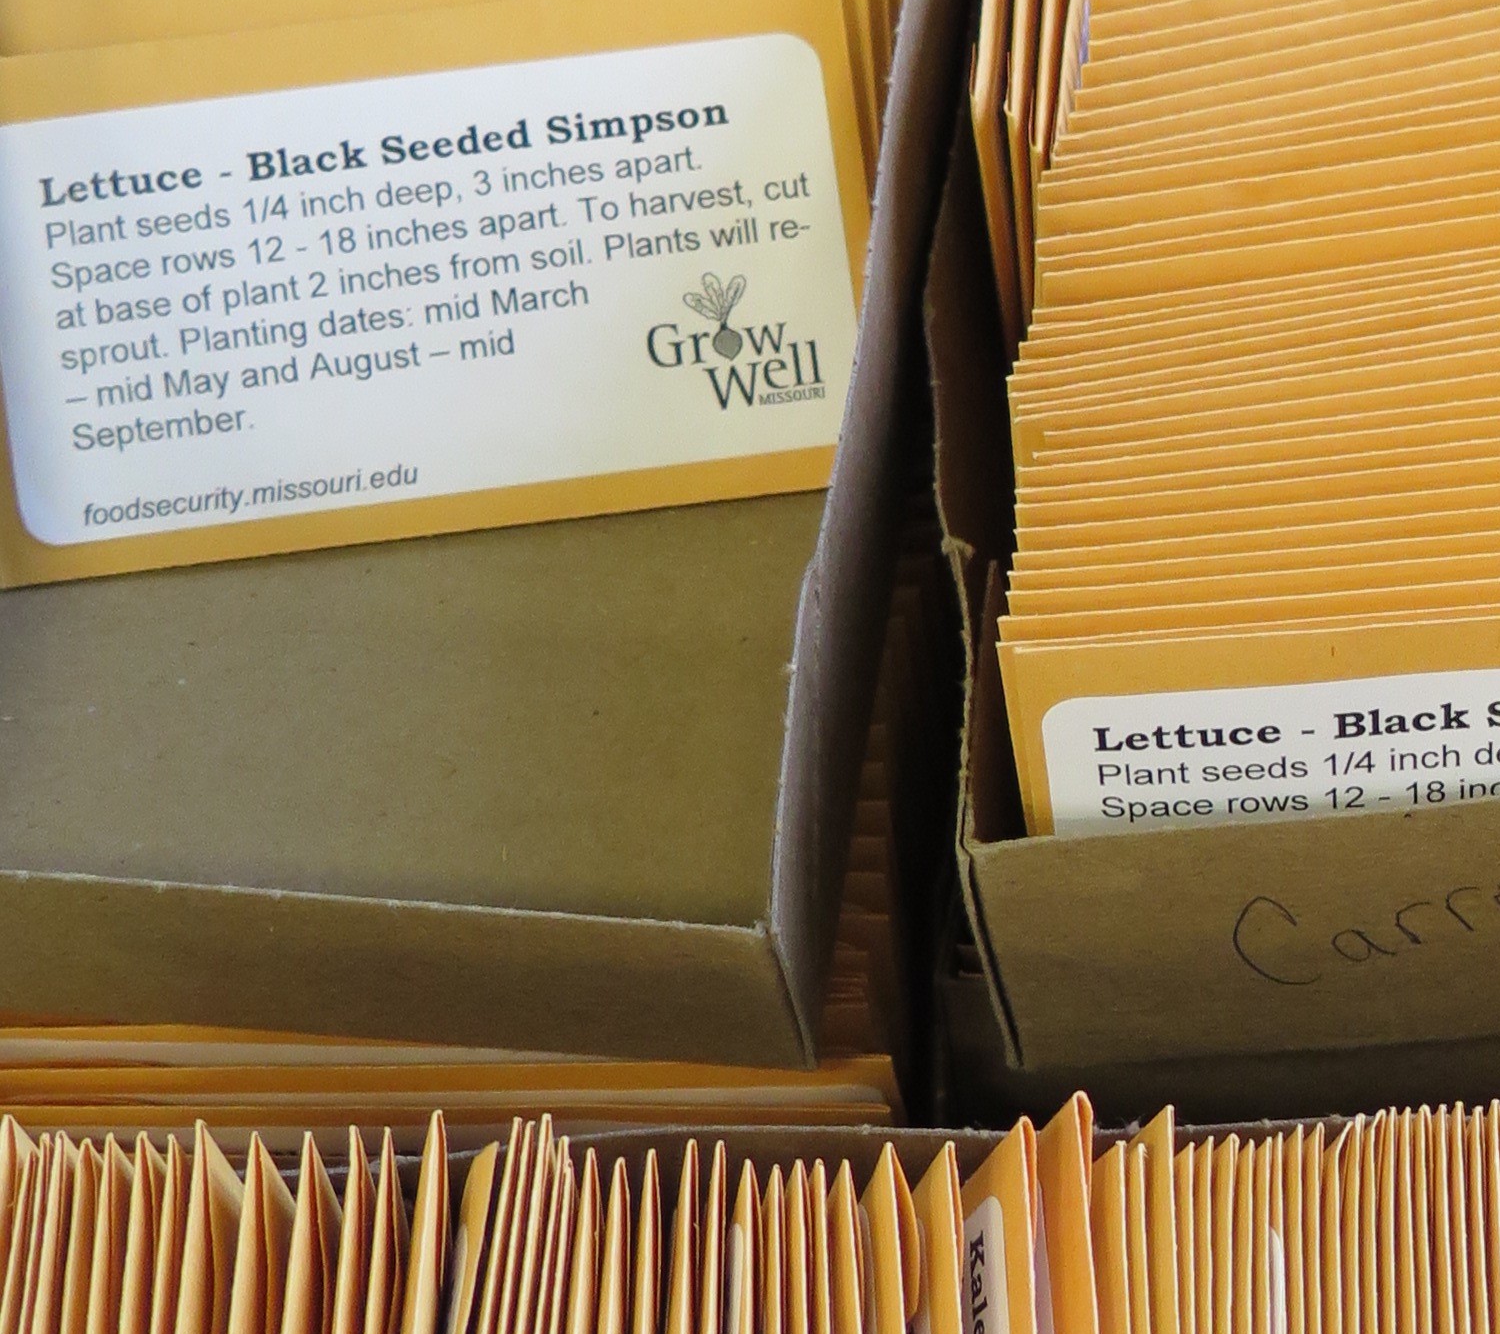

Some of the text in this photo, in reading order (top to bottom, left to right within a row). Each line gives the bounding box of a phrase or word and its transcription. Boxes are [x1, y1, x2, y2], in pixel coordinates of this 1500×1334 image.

[39, 104, 729, 208] Lettuce - Black Seeded Simpson
[46, 146, 702, 250] Plant seeds 1/4 inch deep, 3 inches apart.
[51, 259, 151, 293] Space
[162, 248, 235, 275] rows
[248, 235, 286, 265] 12
[319, 227, 357, 256] 18
[367, 217, 468, 251] inches
[479, 202, 568, 240] apart.
[577, 196, 619, 224] To
[629, 179, 752, 219] harvest,
[763, 172, 811, 203] cut
[56, 219, 811, 330] at base of plant 2 inches from soil. Plants will re-
[61, 280, 589, 374] sprout. Planting dates: mid March
[647, 320, 788, 369] Grow
[97, 374, 152, 408] mid
[163, 369, 230, 400] May
[241, 357, 300, 390] and
[309, 342, 421, 381] August
[459, 329, 516, 362] mid
[703, 339, 826, 411] Well
[758, 386, 827, 407] MISSOURI
[72, 408, 255, 452] September.
[83, 463, 420, 527] foodsecurity.missouri.edu
[1093, 724, 1282, 753] Lettuce
[1333, 702, 1471, 740] Black
[1098, 761, 1191, 786] Plant
[1202, 756, 1309, 782] seeds
[1323, 751, 1376, 776] 1/4
[1389, 744, 1461, 772] inch
[1101, 796, 1214, 823] Space
[1226, 792, 1310, 814] rows
[1323, 786, 1366, 810] 12
[1405, 781, 1447, 805] 18
